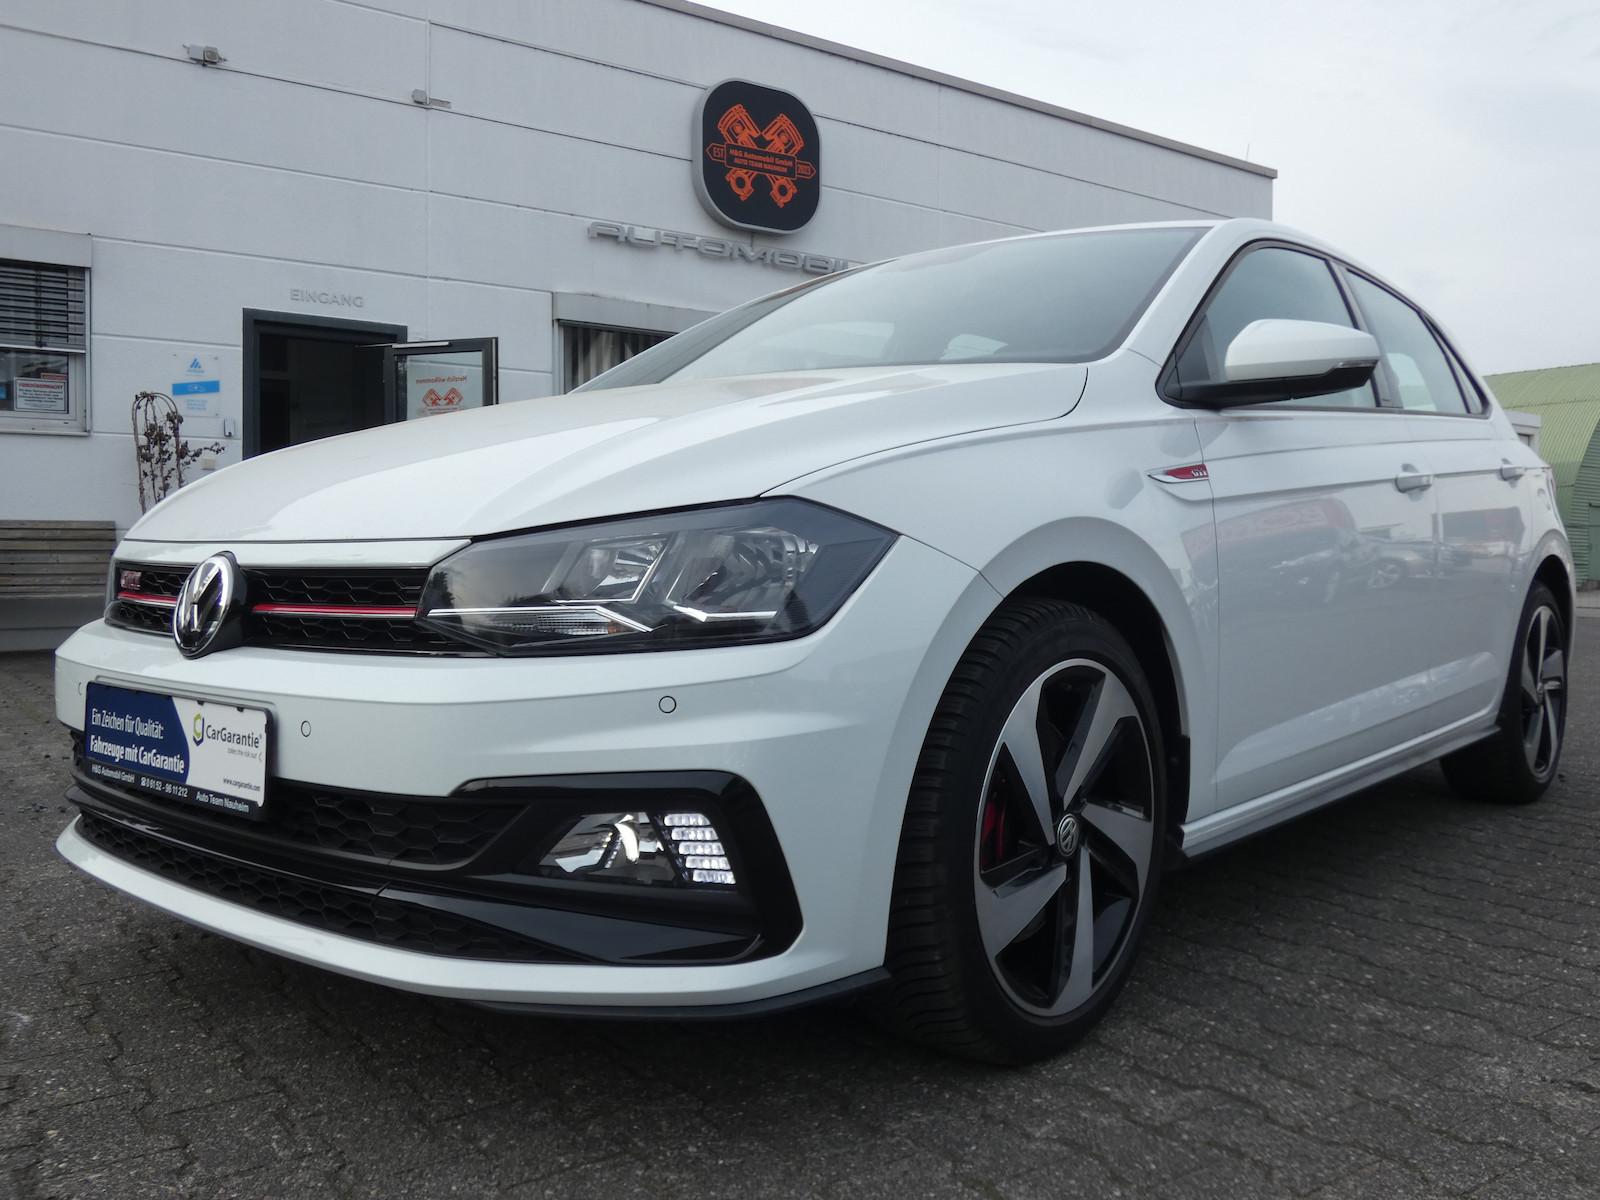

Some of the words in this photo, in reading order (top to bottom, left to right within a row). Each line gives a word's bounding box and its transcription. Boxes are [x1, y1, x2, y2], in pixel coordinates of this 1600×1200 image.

[290, 289, 364, 308] EINGANG
[92, 708, 101, 726] Ein
[101, 710, 124, 732] Zeichen
[125, 714, 135, 733] für
[135, 717, 164, 739] Qualität:
[206, 724, 260, 748] CarGarantie
[89, 735, 124, 762] Fahrzeuge
[125, 744, 138, 762] mit
[139, 746, 185, 773] CarGarantie
[196, 791, 209, 802] Auto
[209, 794, 224, 807] Team
[224, 797, 250, 813] Nauheim
